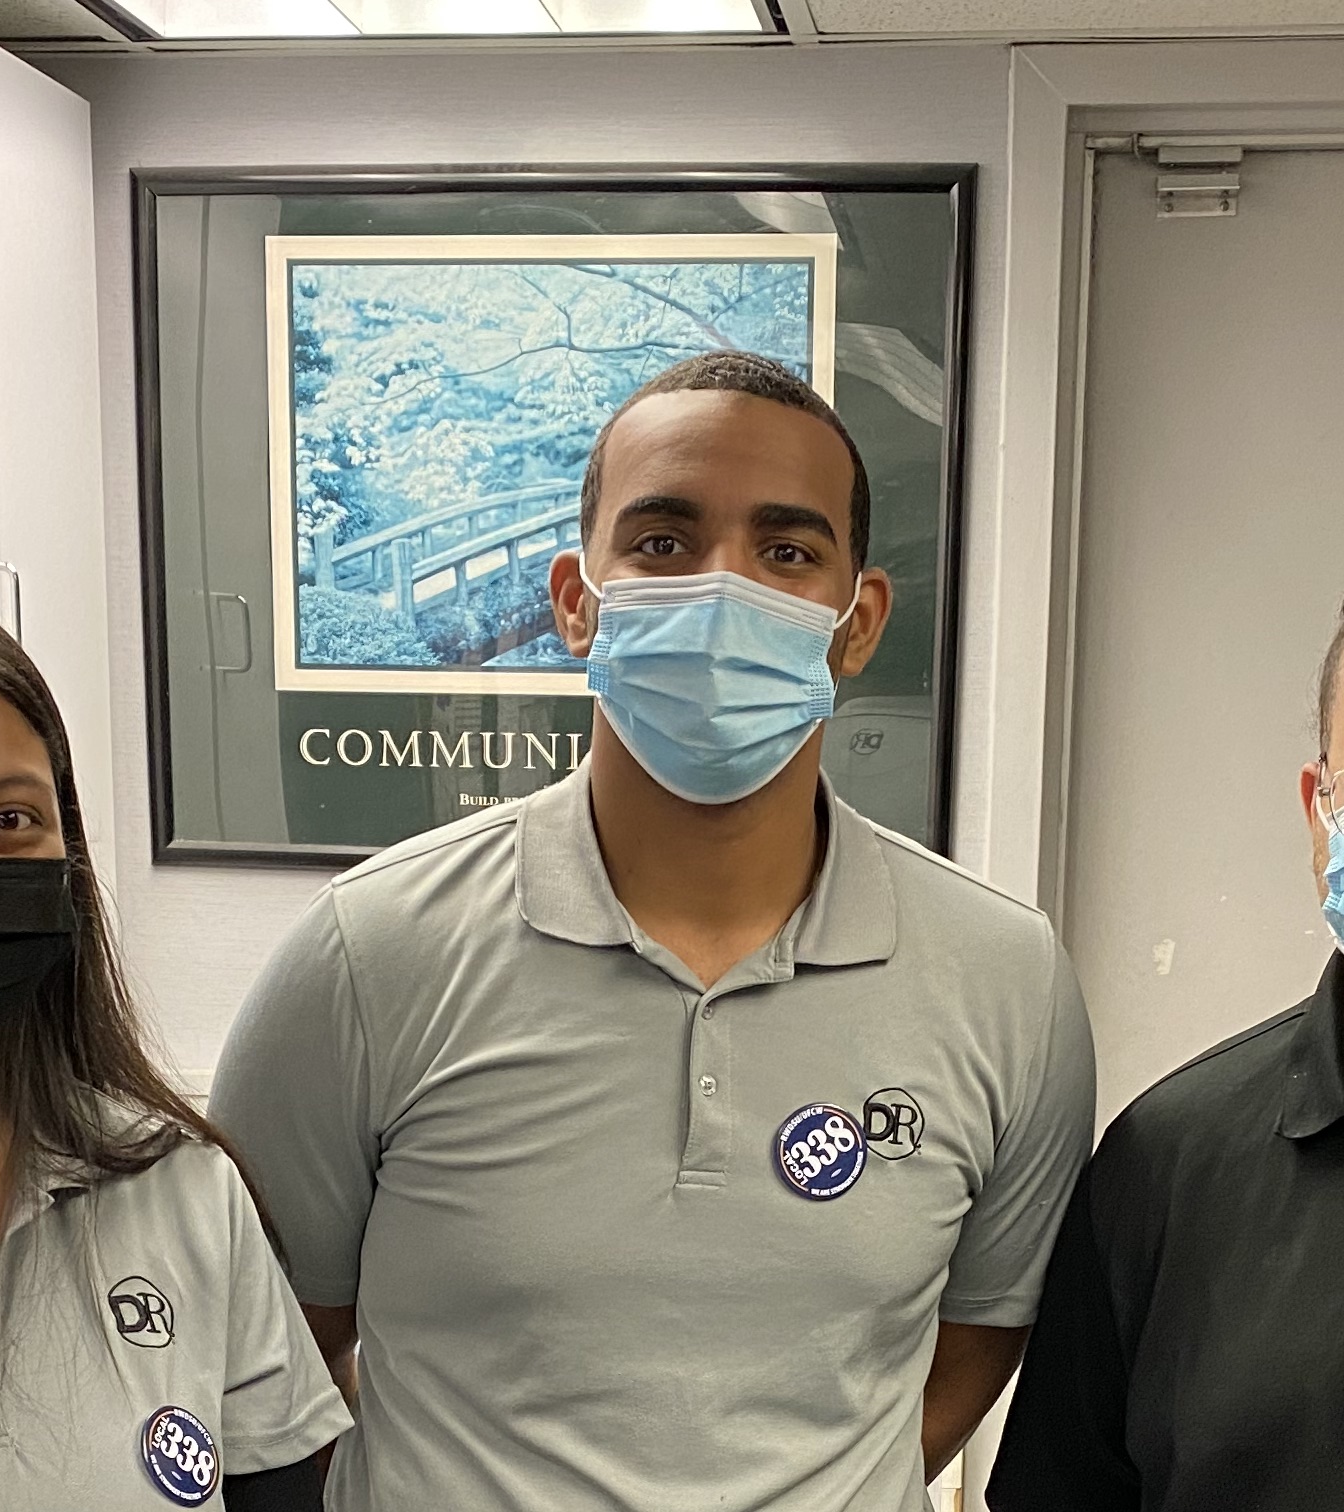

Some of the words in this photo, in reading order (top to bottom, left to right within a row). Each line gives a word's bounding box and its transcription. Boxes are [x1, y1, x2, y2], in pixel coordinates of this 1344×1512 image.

[299, 728, 584, 770] COMMUNI
[790, 1115, 855, 1178] 338
[863, 1102, 922, 1149] DR
[784, 1150, 809, 1185] LOCAL
[108, 1292, 175, 1338] DR
[152, 1416, 170, 1449] LOCAL
[160, 1422, 215, 1487] 338
